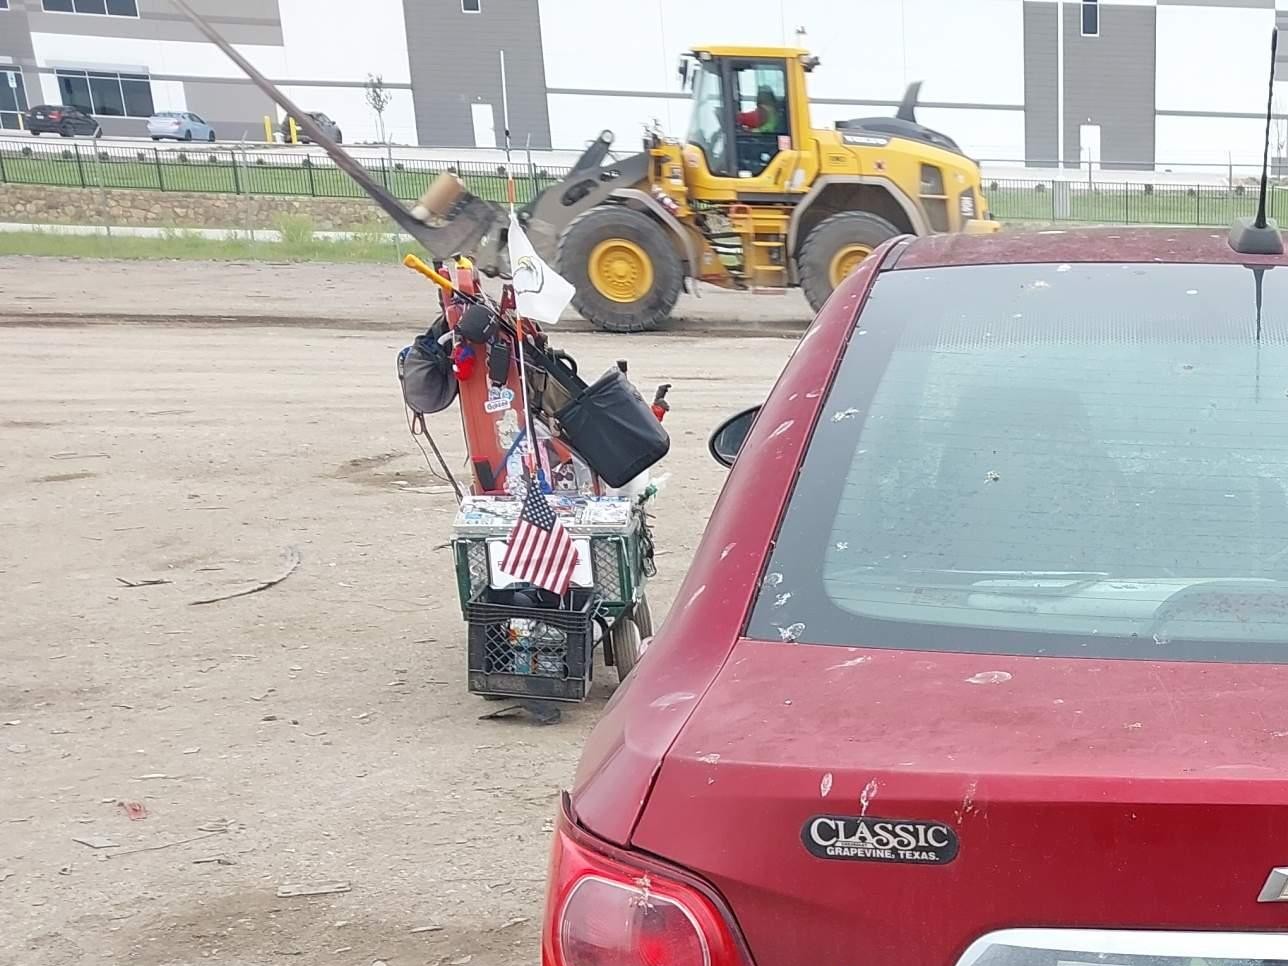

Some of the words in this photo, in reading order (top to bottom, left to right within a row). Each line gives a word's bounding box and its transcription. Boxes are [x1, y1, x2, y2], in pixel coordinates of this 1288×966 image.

[809, 817, 949, 850] CLASSIC
[826, 846, 896, 859] GRAPEVINE,
[899, 850, 940, 861] TEXAS.
